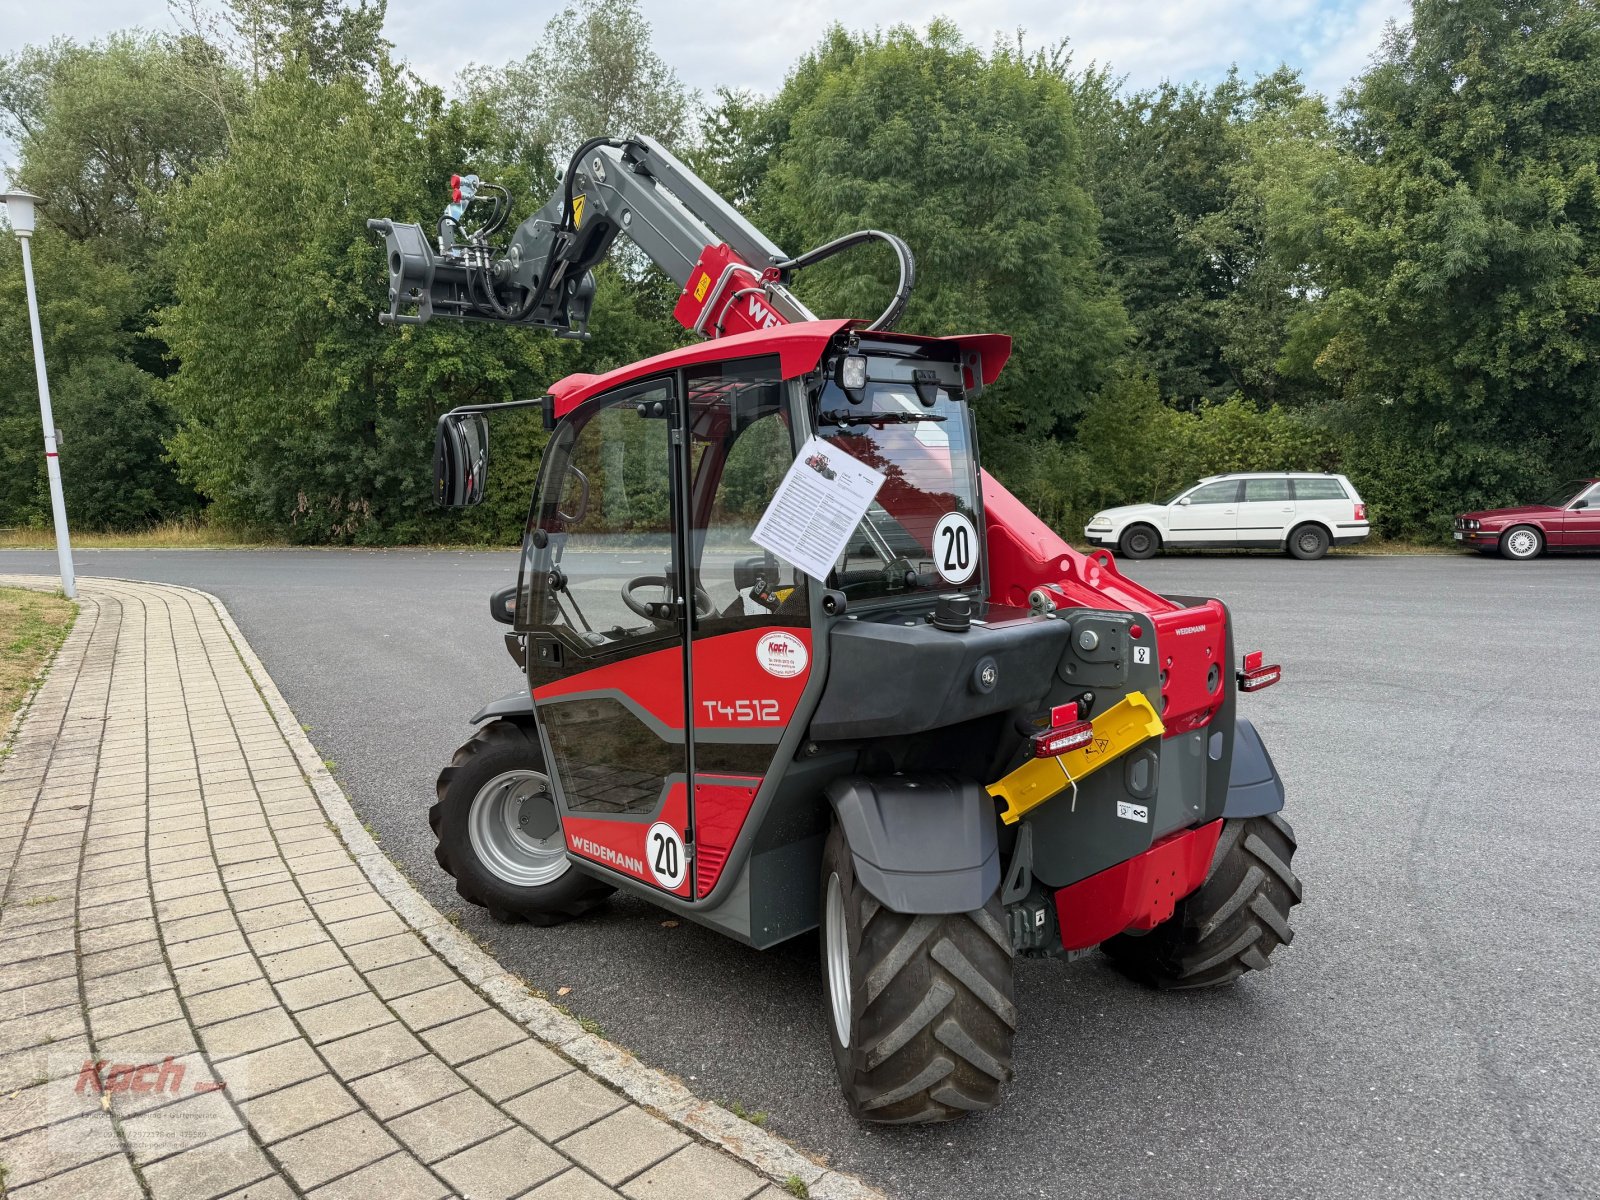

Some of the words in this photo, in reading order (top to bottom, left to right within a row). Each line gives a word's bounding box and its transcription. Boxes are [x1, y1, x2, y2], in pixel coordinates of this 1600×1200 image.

[748, 294, 782, 329] WE
[942, 525, 970, 571] 20
[768, 641, 788, 653] Koch
[1175, 624, 1206, 636] WEIDEMANN
[702, 699, 780, 721] T4512
[570, 834, 644, 875] WEIDEMANN
[653, 832, 678, 879] 20
